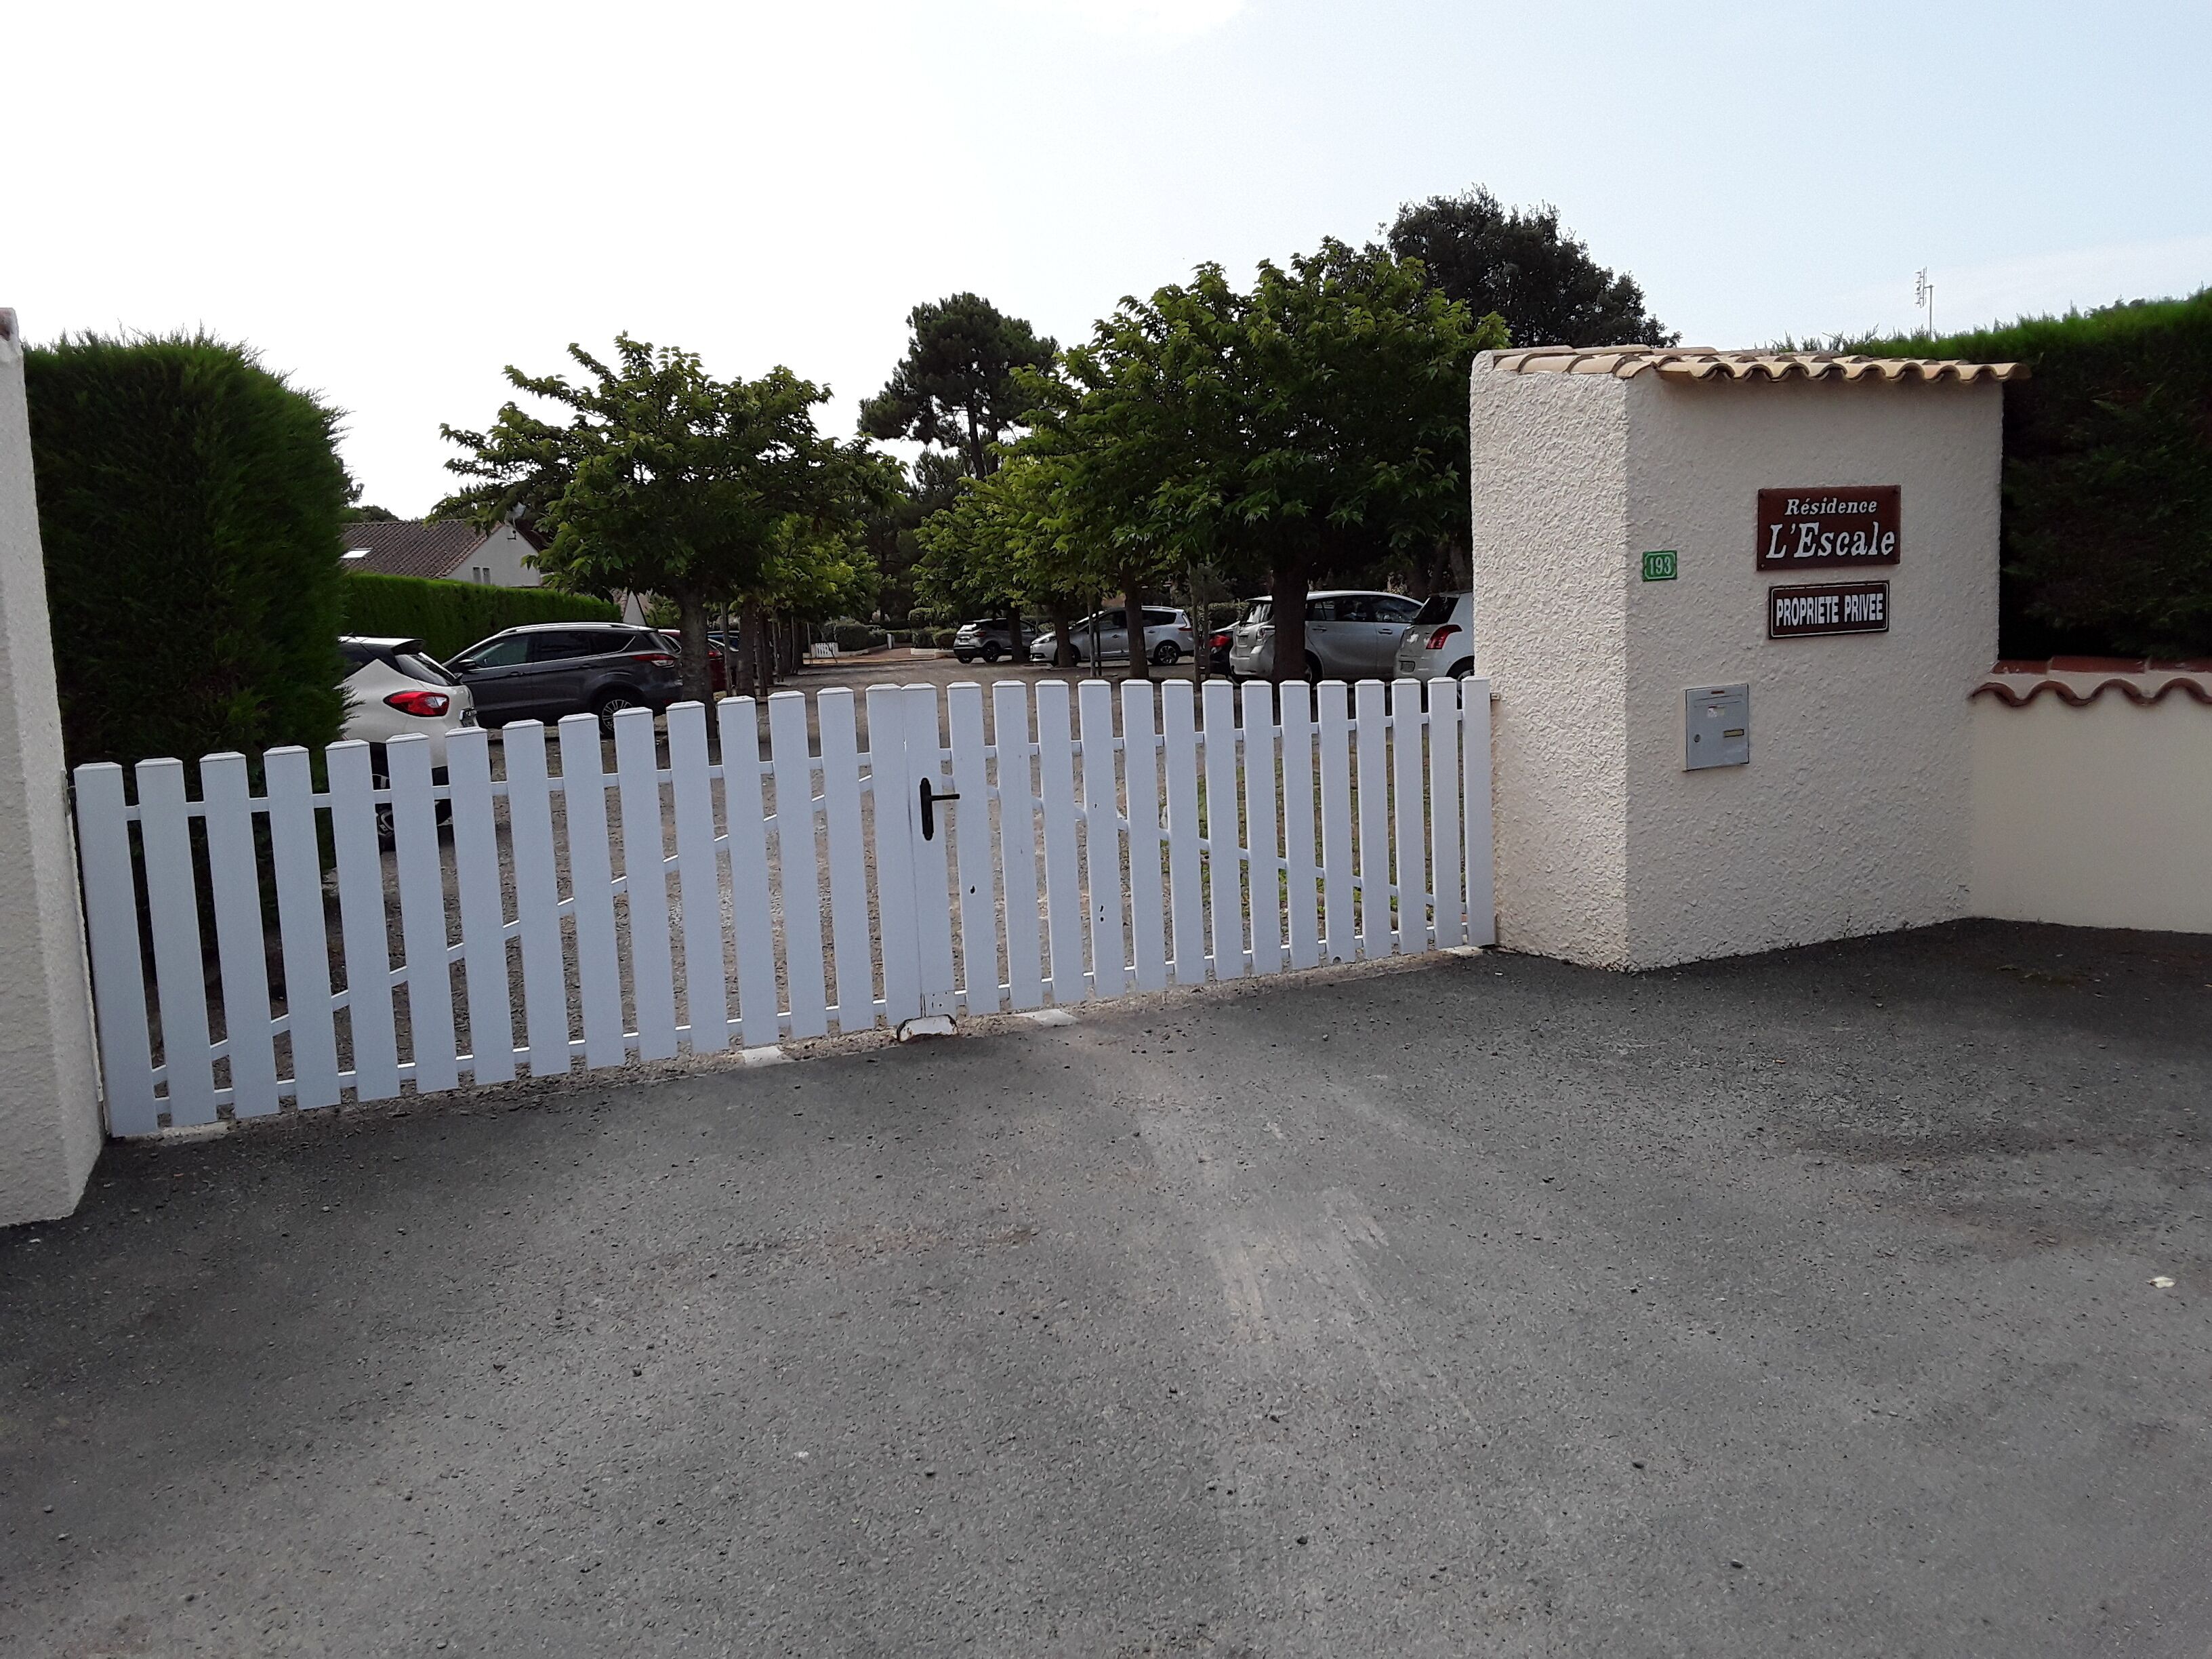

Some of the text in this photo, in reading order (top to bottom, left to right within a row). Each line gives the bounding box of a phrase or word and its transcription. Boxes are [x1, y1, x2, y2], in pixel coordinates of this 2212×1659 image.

[1784, 497, 1877, 515] Résidence
[1766, 521, 1895, 558] L'Escale
[1650, 556, 1672, 575] 193
[1776, 593, 1883, 626] PROPRIETE PRIVEE
